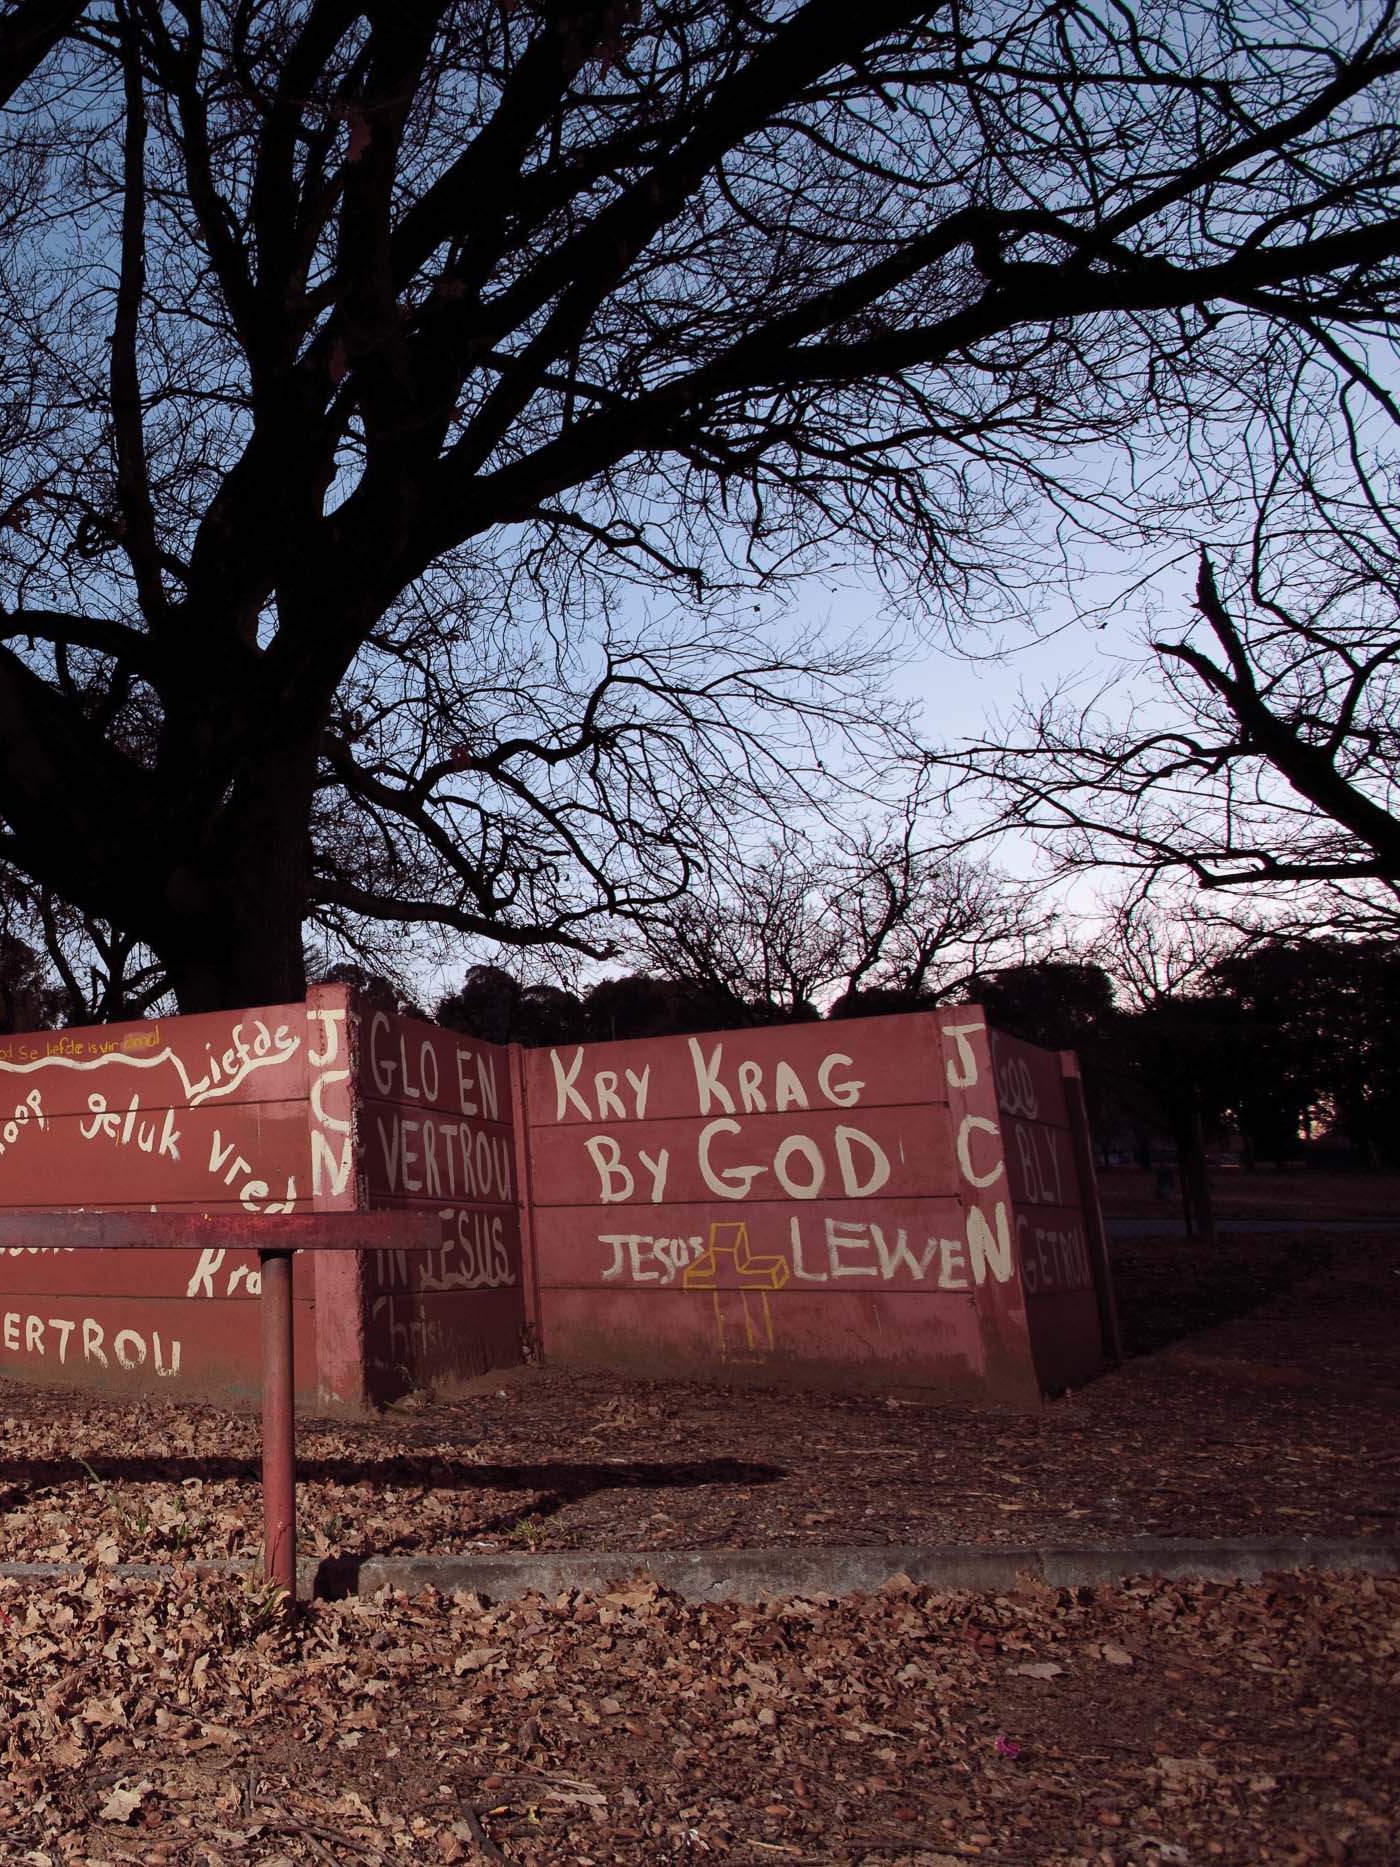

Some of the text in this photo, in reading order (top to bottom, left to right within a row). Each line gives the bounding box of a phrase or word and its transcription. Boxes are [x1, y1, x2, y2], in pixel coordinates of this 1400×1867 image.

[168, 1021, 294, 1100] Liefde
[371, 1010, 498, 1121] GLO EN
[80, 1094, 181, 1160] geluk
[209, 1130, 297, 1214] Vred
[377, 1112, 511, 1201] VERTROU
[699, 1118, 890, 1200] GOD
